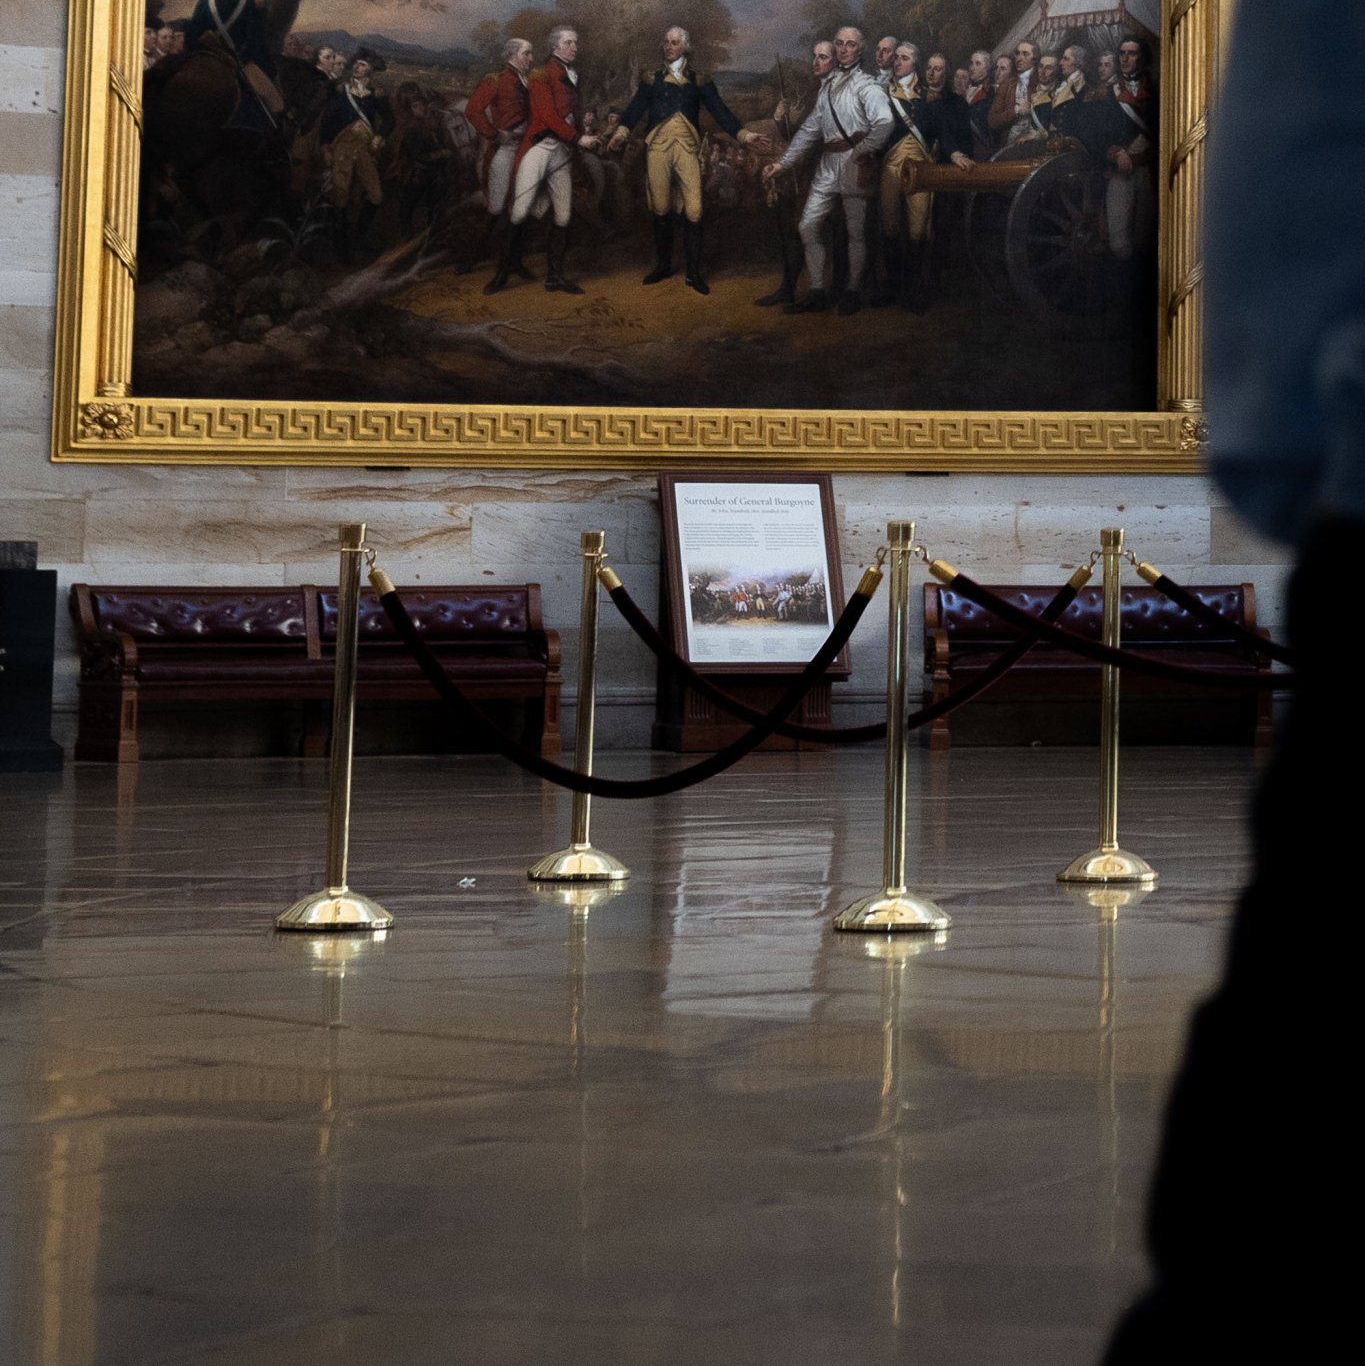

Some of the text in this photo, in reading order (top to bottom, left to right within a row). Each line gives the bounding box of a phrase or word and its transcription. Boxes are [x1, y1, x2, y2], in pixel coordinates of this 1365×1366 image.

[683, 496, 815, 508] Surrender of General Burgoyne
